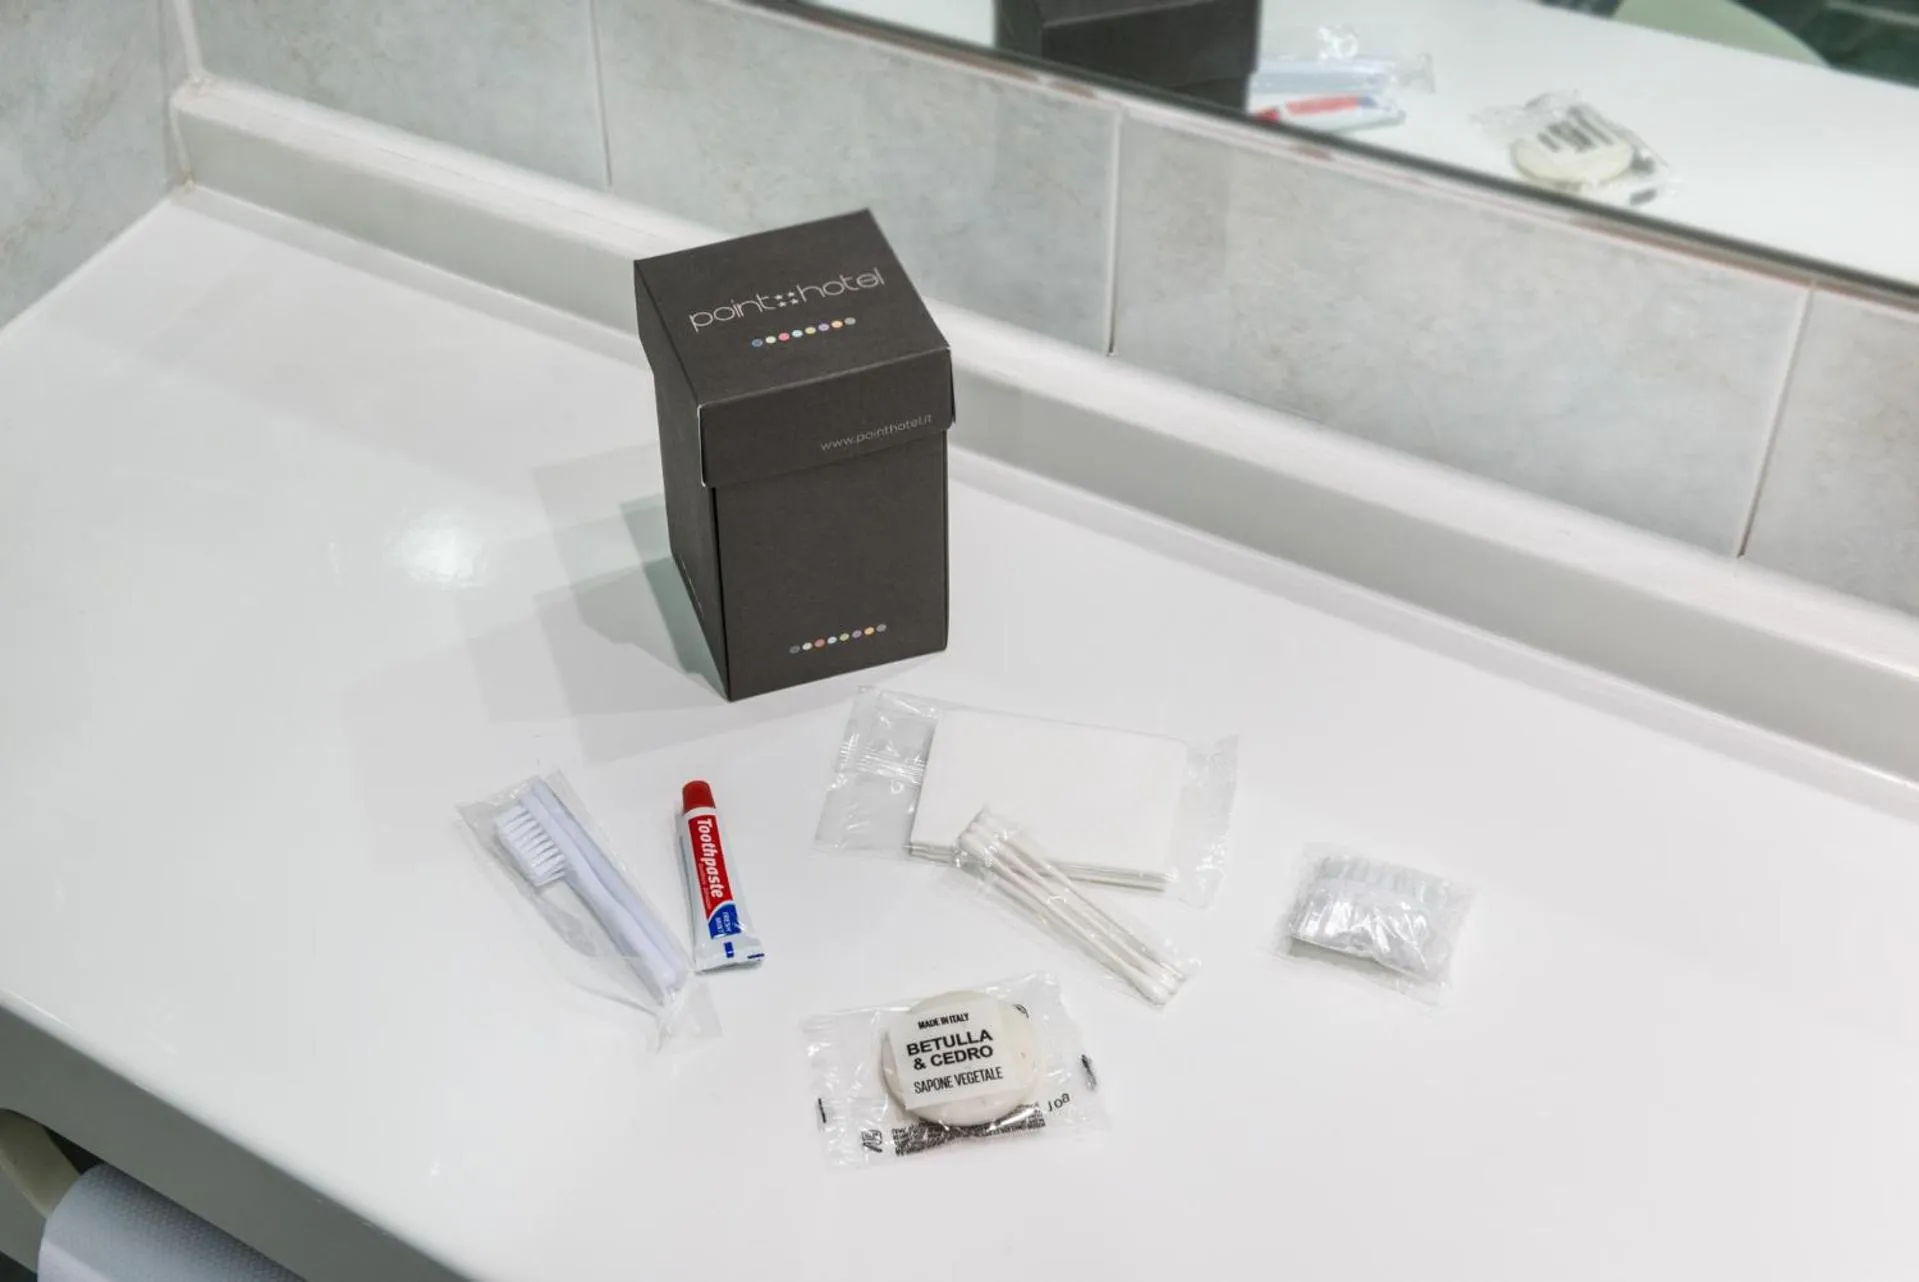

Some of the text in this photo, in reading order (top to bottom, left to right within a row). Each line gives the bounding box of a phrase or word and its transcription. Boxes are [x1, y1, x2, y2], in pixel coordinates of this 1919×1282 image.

[820, 414, 932, 451] www.pointhotel.it
[697, 818, 723, 898] Toothpaste
[918, 1013, 969, 1030] MADE IN ITALY
[906, 1029, 993, 1056] BETULLA
[913, 1045, 993, 1070] & CEDRO
[913, 1066, 1003, 1094] SAPONE VEGETALE
